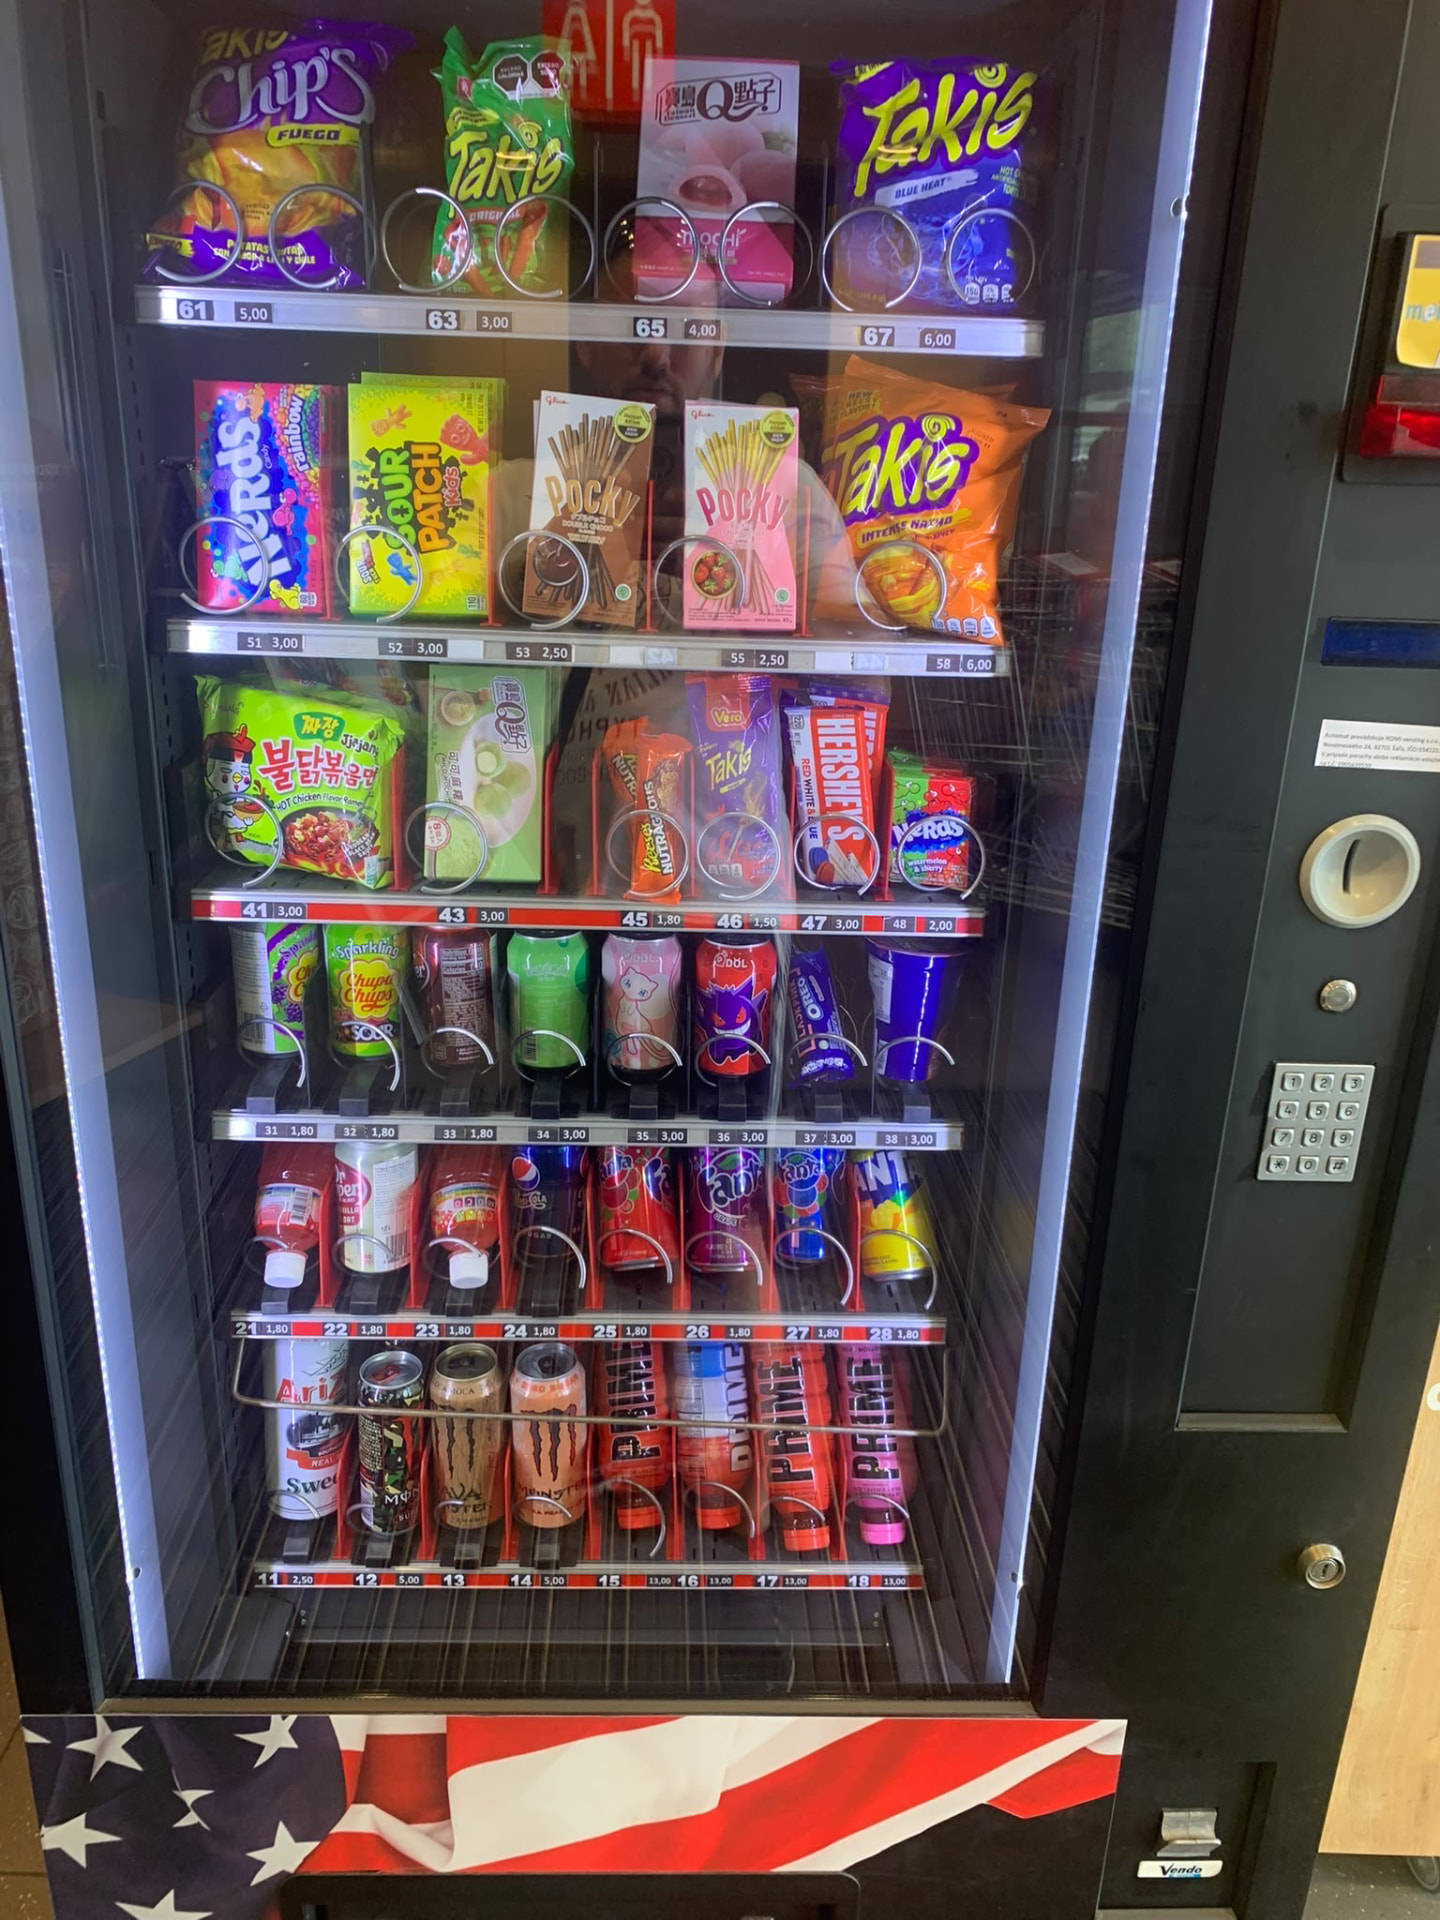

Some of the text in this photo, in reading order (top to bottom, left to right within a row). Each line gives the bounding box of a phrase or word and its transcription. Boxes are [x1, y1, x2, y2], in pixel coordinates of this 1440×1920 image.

[276, 128, 340, 142] FUEGO
[854, 63, 1037, 197] Takis
[448, 122, 562, 218] Takis
[894, 183, 919, 200] BLUE
[179, 301, 267, 321] 61 5,00
[428, 311, 509, 330] 63 3,00
[636, 318, 716, 338] 65 4,00
[864, 328, 952, 348] 67 6,00
[285, 395, 311, 472] rainbow
[822, 413, 970, 518] Takis
[444, 465, 462, 507] Kids
[379, 449, 414, 551] SOUR
[410, 442, 451, 554] PATCH
[247, 637, 299, 650] 51 3,00
[388, 642, 443, 655] 52 3,00
[515, 647, 568, 660] 53 2,50
[731, 653, 785, 667] 55 2,50
[936, 659, 992, 671] 58 6,00
[714, 710, 742, 723] Vero
[302, 715, 339, 738] 짜장
[705, 740, 752, 792] Takis
[801, 758, 815, 816] RED WHITE &
[276, 799, 291, 811] HOT
[292, 793, 321, 804] Chicken
[908, 857, 948, 866] watermelon
[920, 865, 943, 873] cherry
[243, 903, 303, 918] 41 3,00
[439, 908, 505, 923] 43 3,00
[622, 912, 681, 927] 45 1,80
[717, 914, 777, 928] 46 1,50
[802, 916, 859, 931] 47 3,00
[893, 919, 952, 932] 48 2,00
[335, 940, 400, 960] Sparkling
[346, 973, 393, 991] Chupa
[345, 987, 393, 1012] Chups
[797, 976, 822, 1020] OREO
[1291, 1077, 1296, 1087] 1
[1319, 1078, 1328, 1089] 2
[1350, 1079, 1358, 1089] 3
[1284, 1106, 1292, 1115] 4
[1315, 1106, 1323, 1116] 5
[1344, 1106, 1353, 1117] 6
[265, 1126, 314, 1137] 31 1,80
[343, 1127, 395, 1138] 32 1,80
[443, 1129, 493, 1140] 33 1,80
[536, 1130, 586, 1141] 34 3,00
[636, 1131, 684, 1142] 35 3,00
[717, 1132, 765, 1143] 36 3,00
[1279, 1132, 1288, 1142] 7
[1309, 1133, 1317, 1143] 8
[804, 1133, 853, 1144] 37 3,00
[885, 1135, 934, 1145] 38 3,00
[1339, 1133, 1347, 1144] 9
[1304, 1160, 1313, 1170] 0
[235, 1322, 289, 1335] 21 1,80
[324, 1323, 383, 1336] 22 1,80
[416, 1324, 471, 1337] 23 1,80
[504, 1324, 556, 1338] 24 1,80
[594, 1325, 647, 1338] 25 1,80
[686, 1326, 751, 1339] 26 1,80
[786, 1327, 840, 1340] 27 1,80
[869, 1328, 919, 1341] 28 1,80
[757, 1356, 816, 1482] PRIME
[846, 1357, 901, 1480] PRIME
[258, 1573, 313, 1585] 11 2,50
[356, 1573, 420, 1586] 12 5,00
[443, 1574, 465, 1586] 13
[511, 1574, 565, 1586] 14 5,00
[599, 1575, 671, 1587] 15 13,00
[677, 1575, 732, 1587] 16 13,00
[757, 1576, 807, 1587] 17 13,00
[849, 1576, 906, 1587] 18 13,00
[1160, 1863, 1203, 1876] Vendo
